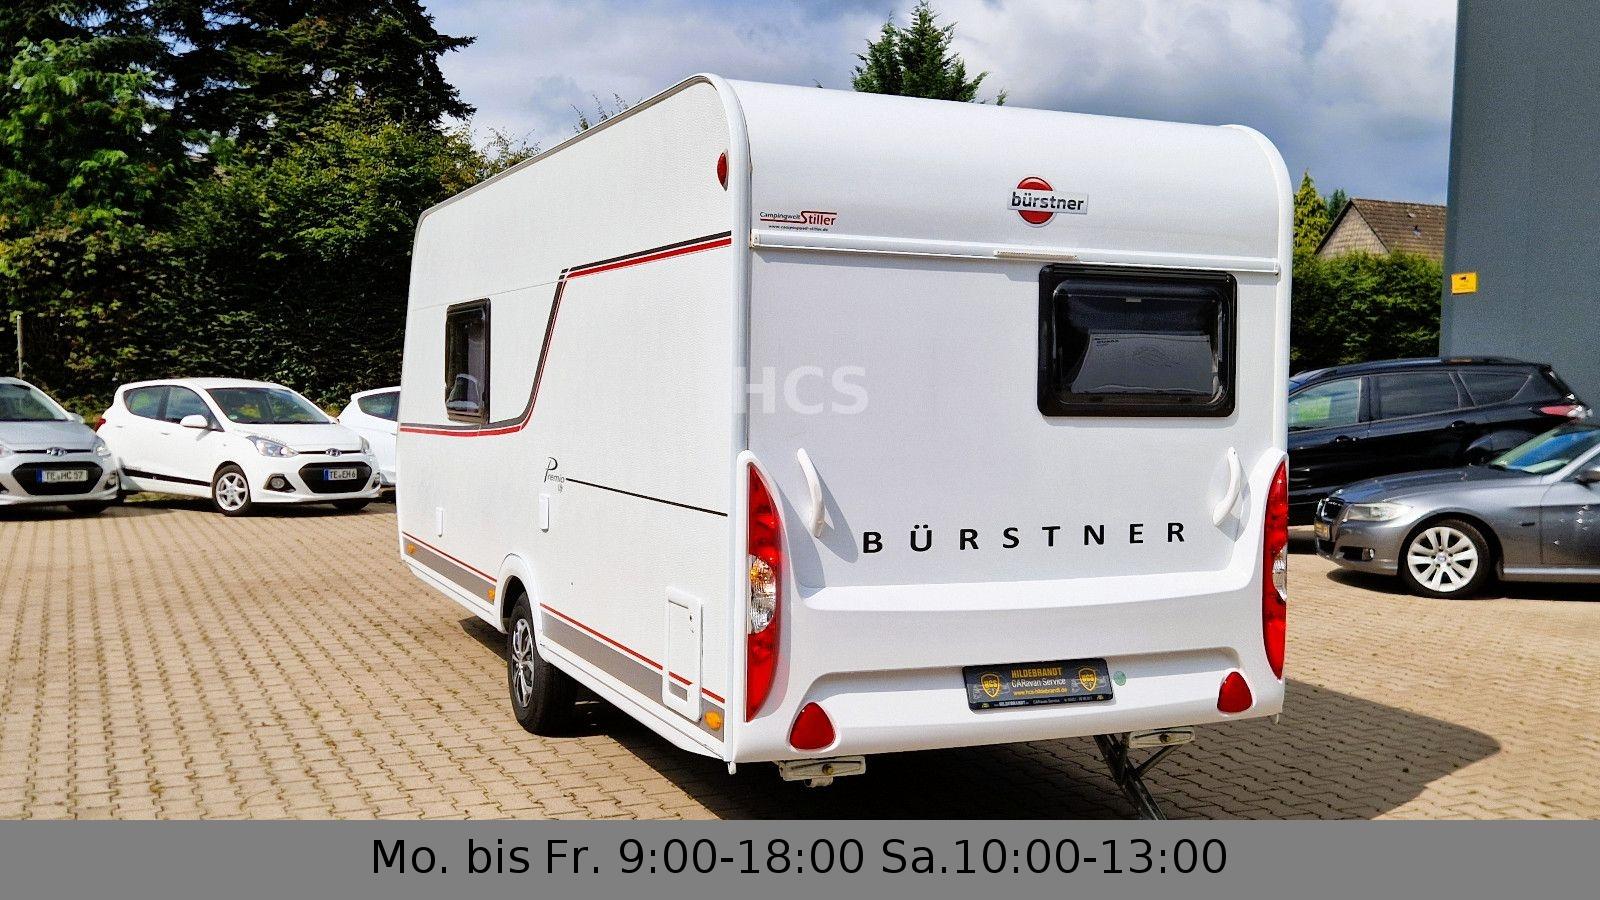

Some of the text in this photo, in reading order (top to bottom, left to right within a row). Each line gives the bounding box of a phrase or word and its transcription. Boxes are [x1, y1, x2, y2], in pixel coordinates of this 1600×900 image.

[1011, 191, 1084, 211] bürstner
[800, 210, 838, 226] Stiller
[862, 522, 1186, 554] BÜRSTNER
[1011, 666, 1063, 679] HILDEBRANDT
[1042, 677, 1067, 687] Service
